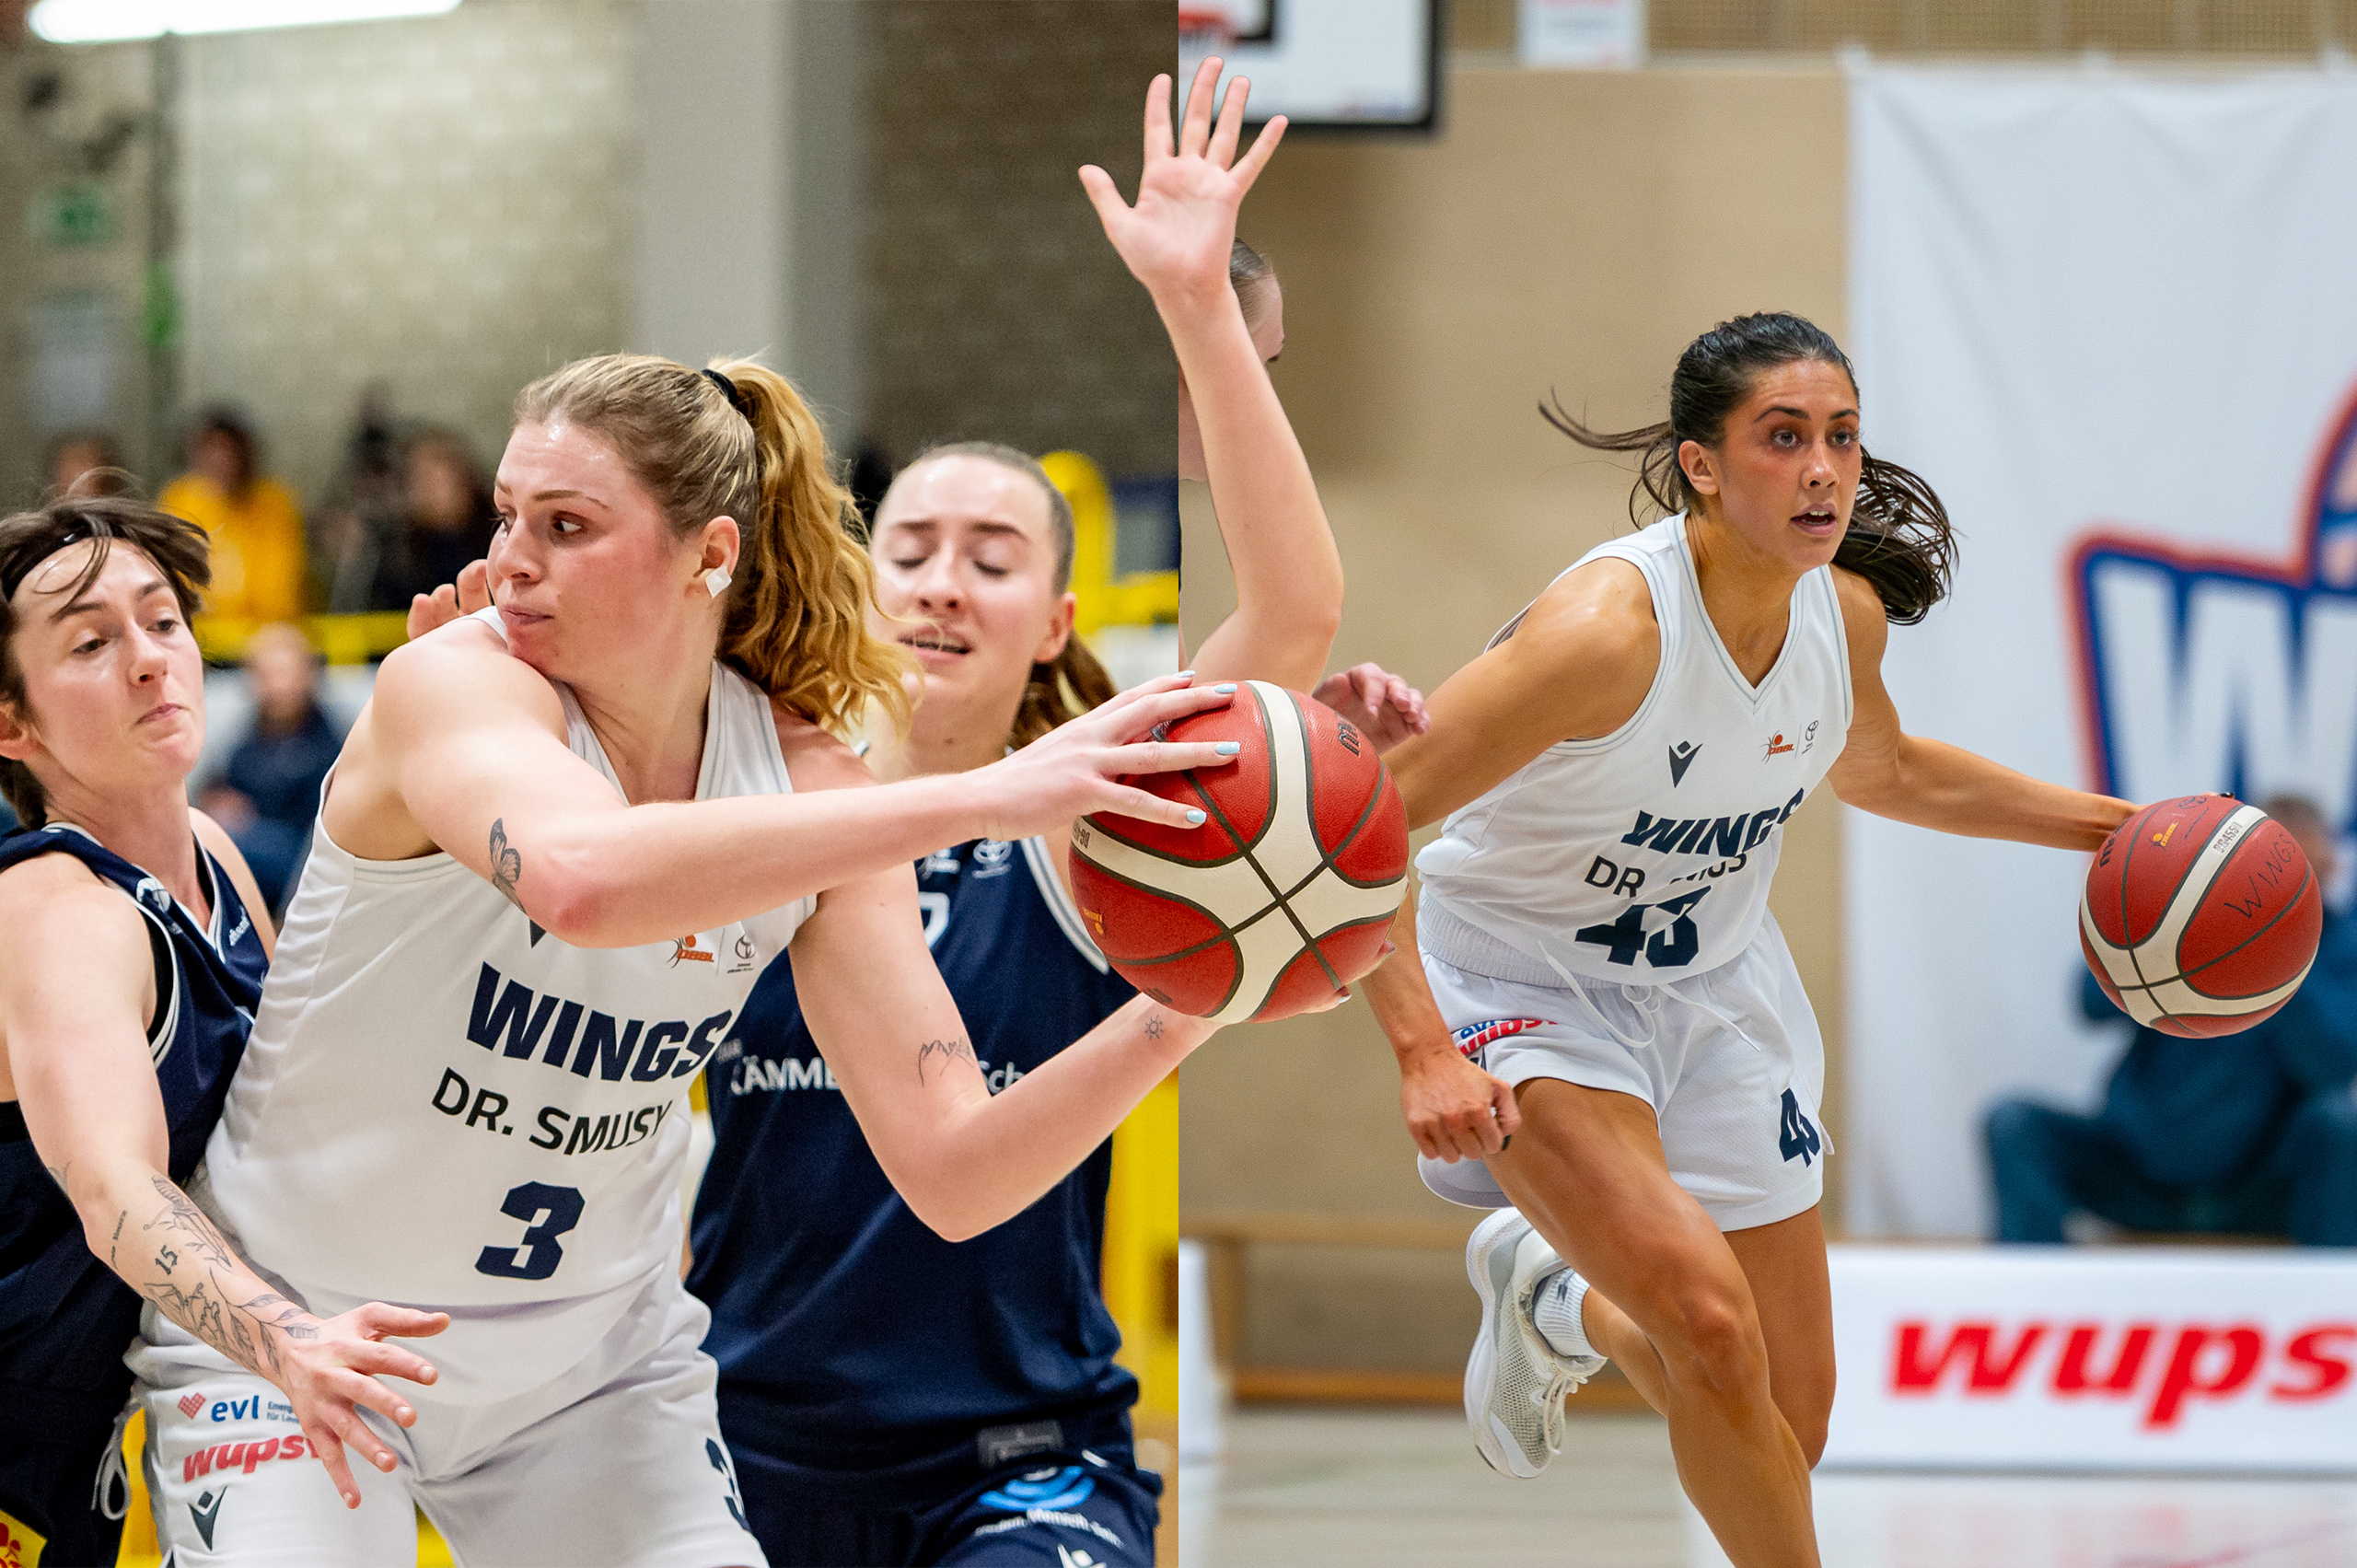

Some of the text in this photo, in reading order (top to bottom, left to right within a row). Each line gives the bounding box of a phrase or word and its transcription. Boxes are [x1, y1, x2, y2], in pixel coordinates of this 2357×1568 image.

[2223, 833, 2296, 919] WINGS
[466, 960, 734, 1083] WINGS
[431, 1066, 673, 1156] DR. SMUSY
[155, 1244, 179, 1275] 15
[474, 1180, 586, 1281] 3
[210, 1394, 260, 1423] evl
